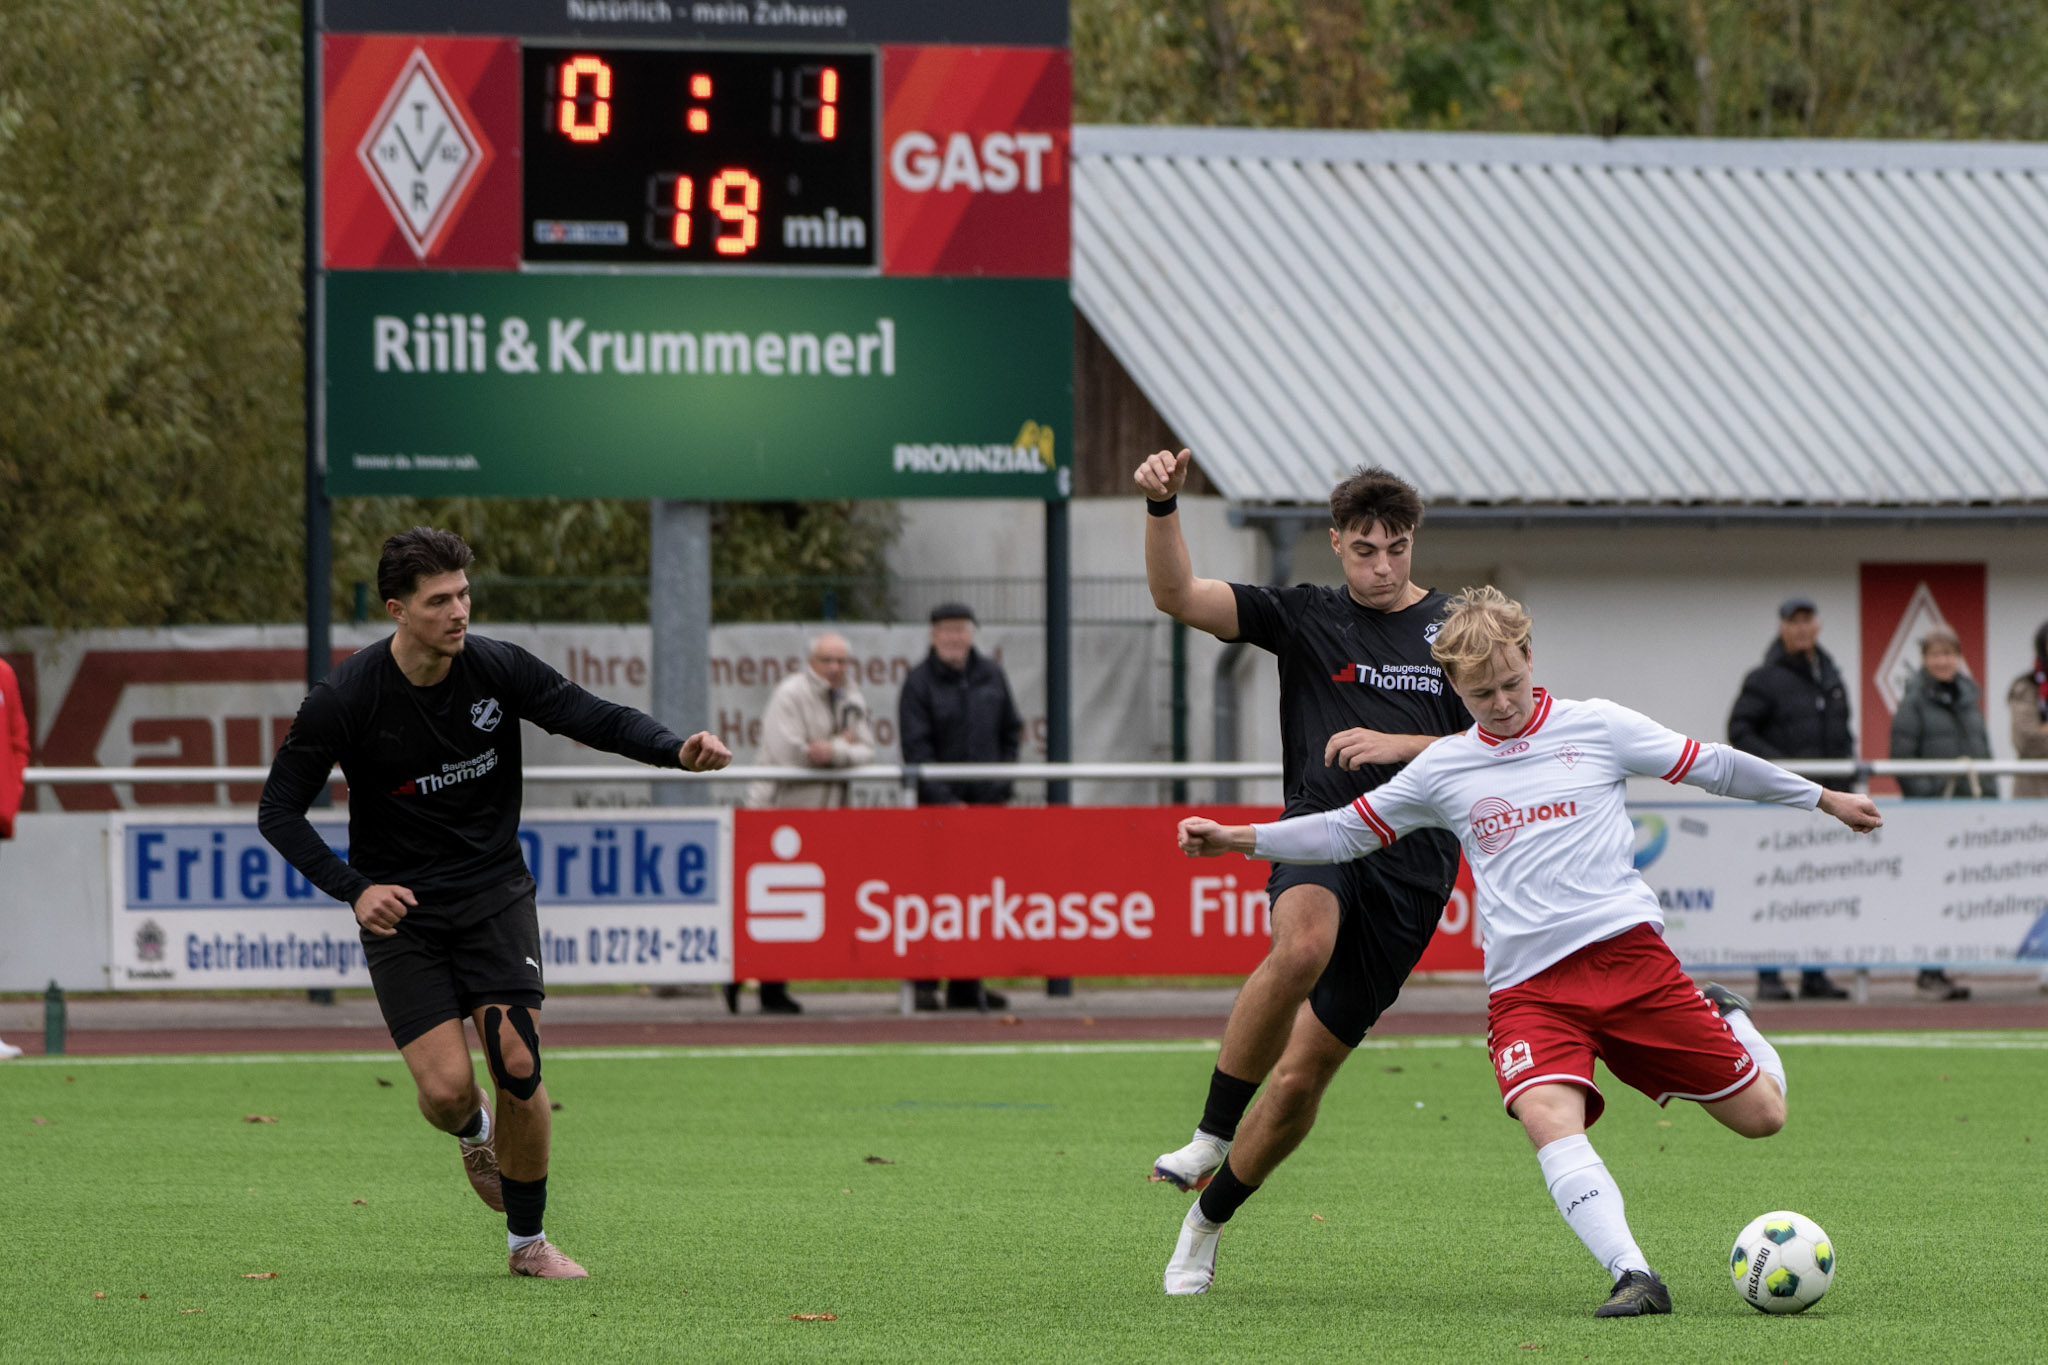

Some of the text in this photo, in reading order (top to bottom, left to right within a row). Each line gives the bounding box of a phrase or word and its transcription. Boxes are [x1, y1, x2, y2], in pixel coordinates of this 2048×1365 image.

[692, 2, 749, 24] mein
[752, 2, 848, 26] Zuhause
[560, 57, 611, 142] 0
[819, 66, 838, 140] 1
[889, 130, 1053, 195] GAST
[411, 181, 429, 211] R
[672, 169, 760, 254] 19
[783, 206, 866, 248] min
[372, 313, 897, 376] Riili & Krummenerl
[893, 444, 1047, 473] PROVINZIAL
[565, 648, 647, 687] Ihre
[1382, 664, 1442, 677] Baugeschäft
[441, 748, 496, 772] Baugeschäft
[1526, 801, 1577, 823] JOKI
[1771, 855, 1903, 886] Aufbereitung
[854, 876, 1155, 957] Sparkasse
[1566, 1189, 1599, 1216] JAKO
[1748, 1247, 1771, 1301] DERBYSTAR
